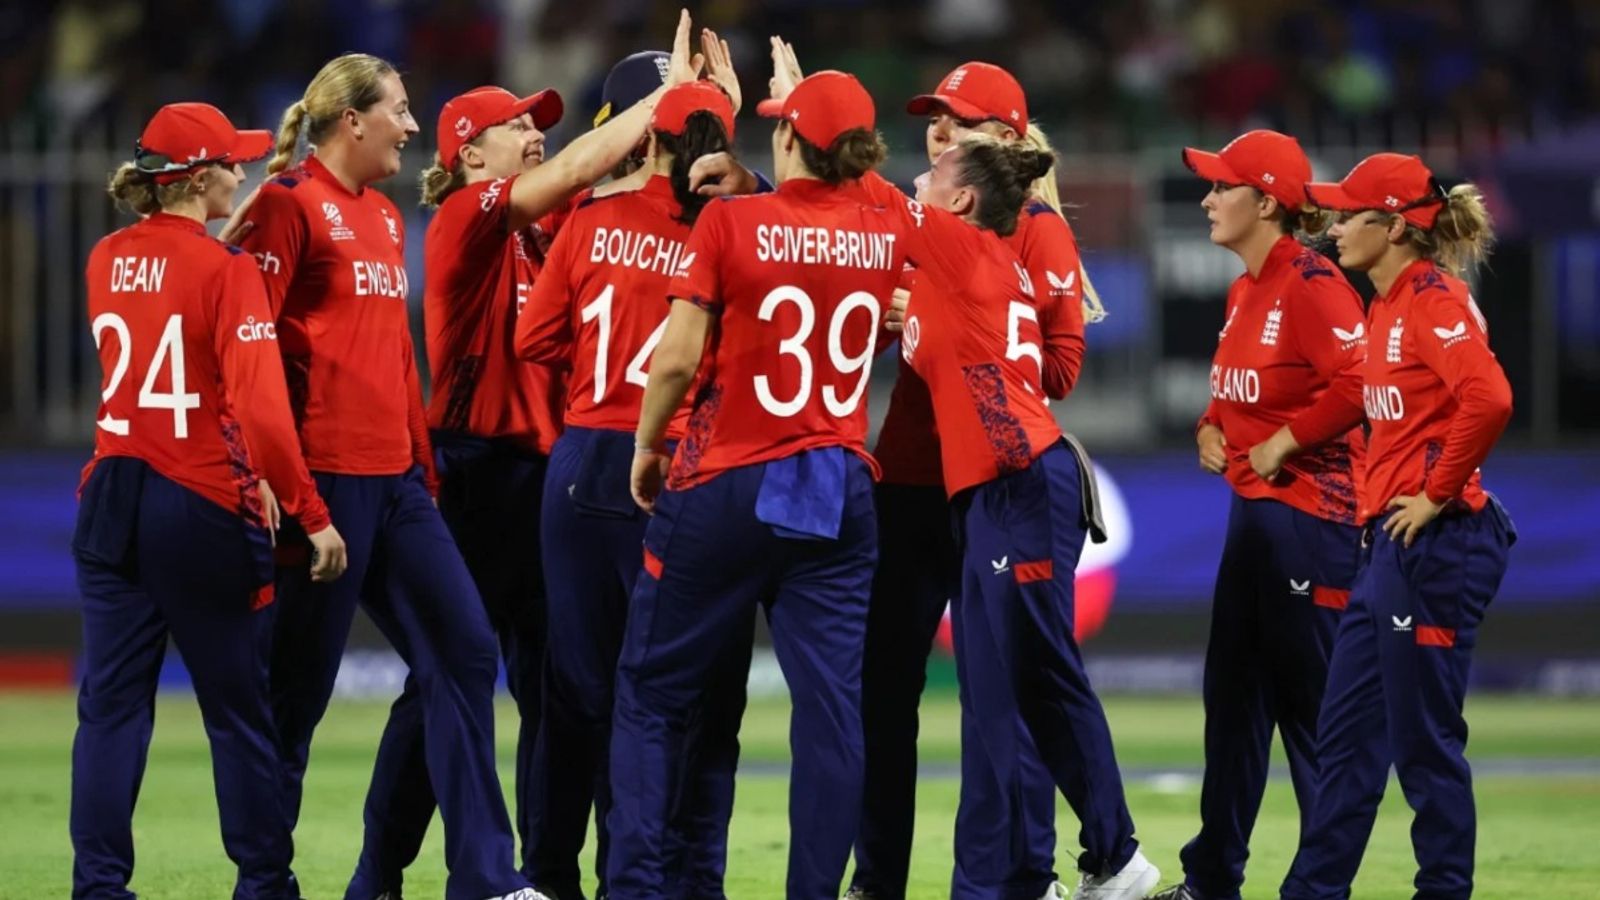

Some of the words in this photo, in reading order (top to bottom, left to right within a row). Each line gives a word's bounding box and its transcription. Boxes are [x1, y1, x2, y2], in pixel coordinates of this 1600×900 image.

[590, 227, 687, 277] BOUCHI
[756, 224, 896, 270] SCIVER-BRUNT
[110, 257, 166, 292] DEAN
[92, 312, 200, 439] 24
[753, 285, 881, 418] 39
